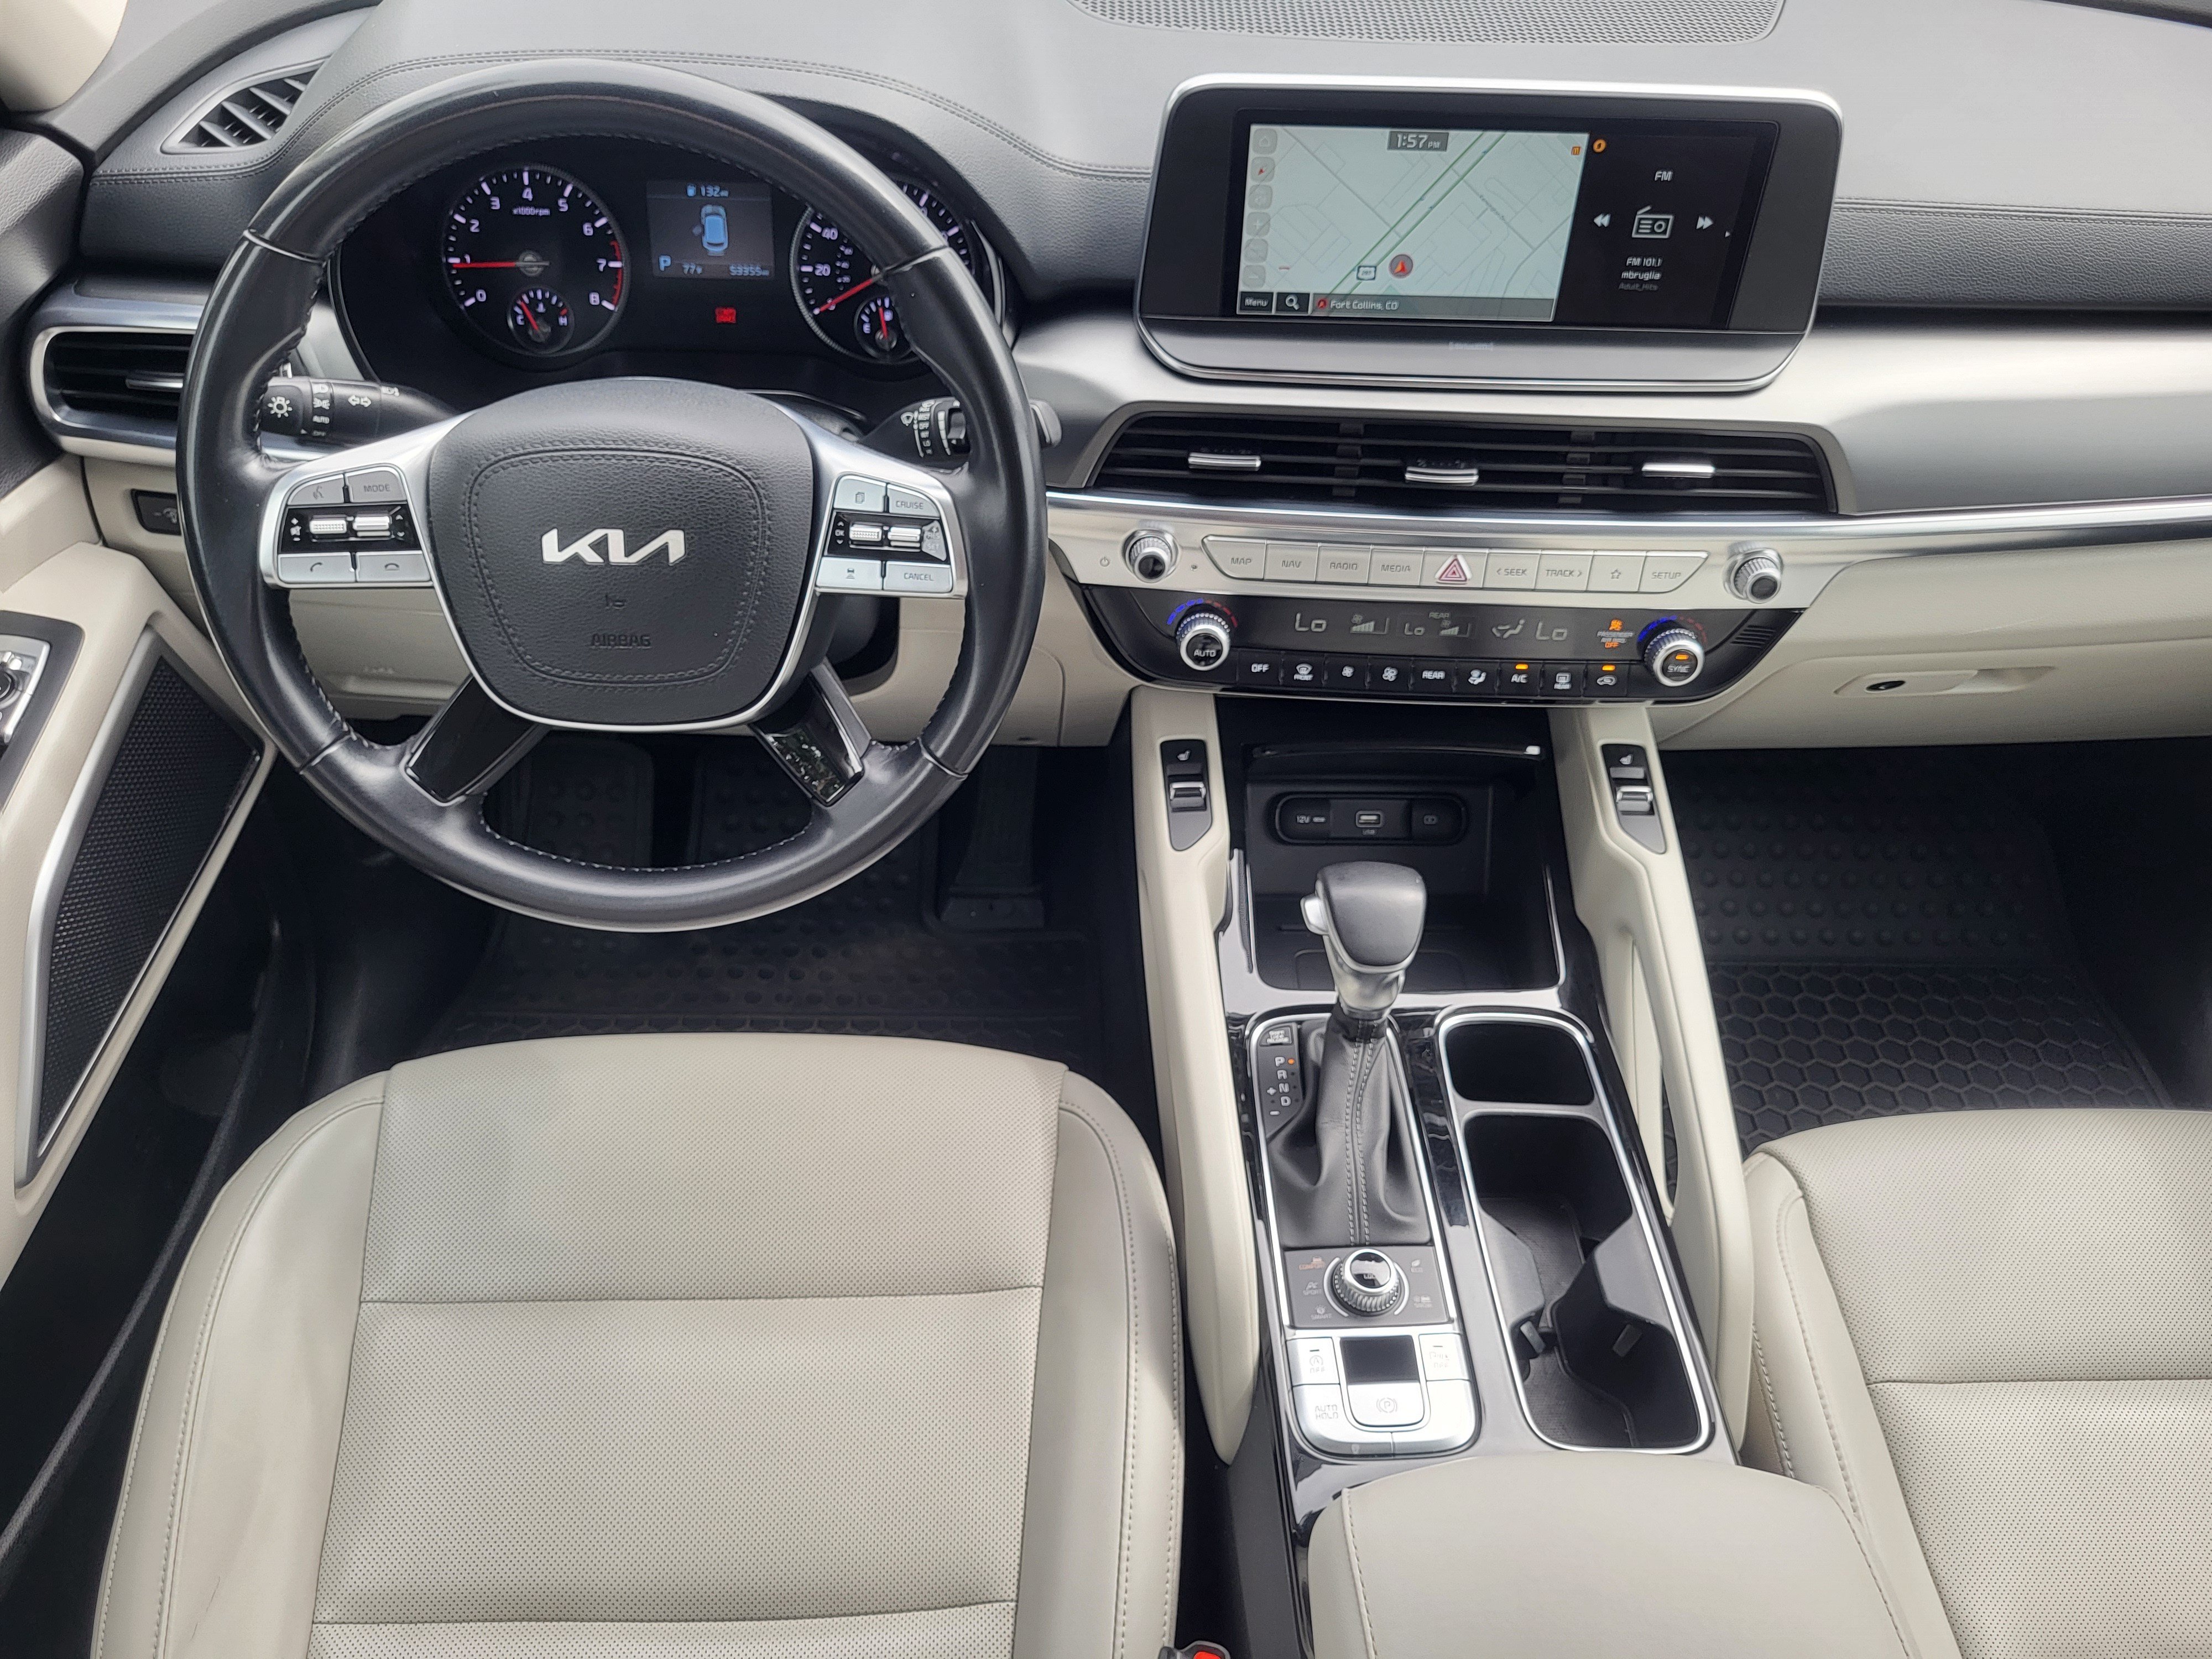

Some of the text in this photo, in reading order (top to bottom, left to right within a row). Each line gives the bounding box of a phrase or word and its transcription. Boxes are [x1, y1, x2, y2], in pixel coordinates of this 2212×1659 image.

[1397, 133, 1441, 149] 1:57 PM
[1655, 170, 1673, 181] FM
[522, 187, 533, 201] 4
[490, 196, 500, 210] 3
[557, 198, 568, 212] 5
[469, 219, 480, 232] 2
[582, 222, 594, 236] 6
[596, 258, 607, 272] 7
[659, 254, 671, 272] P
[1626, 257, 1662, 267] FM 101.1
[815, 263, 831, 276] 20
[1621, 270, 1661, 281] mbruglia
[476, 289, 487, 302] 0
[589, 291, 600, 306] 8
[1245, 296, 1269, 307] Menu
[1330, 299, 1400, 311] Fort Collins, CO
[312, 415, 330, 424] AUTO
[364, 483, 390, 493] MODE
[895, 500, 924, 510] CRUISE
[834, 529, 845, 538] OK
[541, 528, 686, 566] KIA
[1230, 557, 1252, 565] MAP
[1281, 560, 1302, 568] NAV
[1329, 562, 1358, 571] RADIO
[1381, 564, 1411, 573] MEDIA
[904, 572, 935, 582] CANCEL
[1545, 568, 1574, 577] TRACK
[1651, 571, 1681, 580] SETUP
[1295, 612, 1327, 632] Lo
[1535, 621, 1568, 641] Lo
[591, 633, 652, 649] AIRBAG
[1193, 648, 1216, 658] AUTO
[1251, 663, 1270, 672] OFF
[1667, 665, 1691, 673] SYNC
[1422, 670, 1446, 680] REAR
[1511, 674, 1528, 684] A/C
[1275, 1056, 1285, 1067] P
[1277, 1070, 1287, 1080] R
[1279, 1083, 1290, 1093] N
[1280, 1096, 1291, 1107] D
[1314, 1404, 1337, 1412] AUTO
[1316, 1412, 1338, 1420] HOLD
